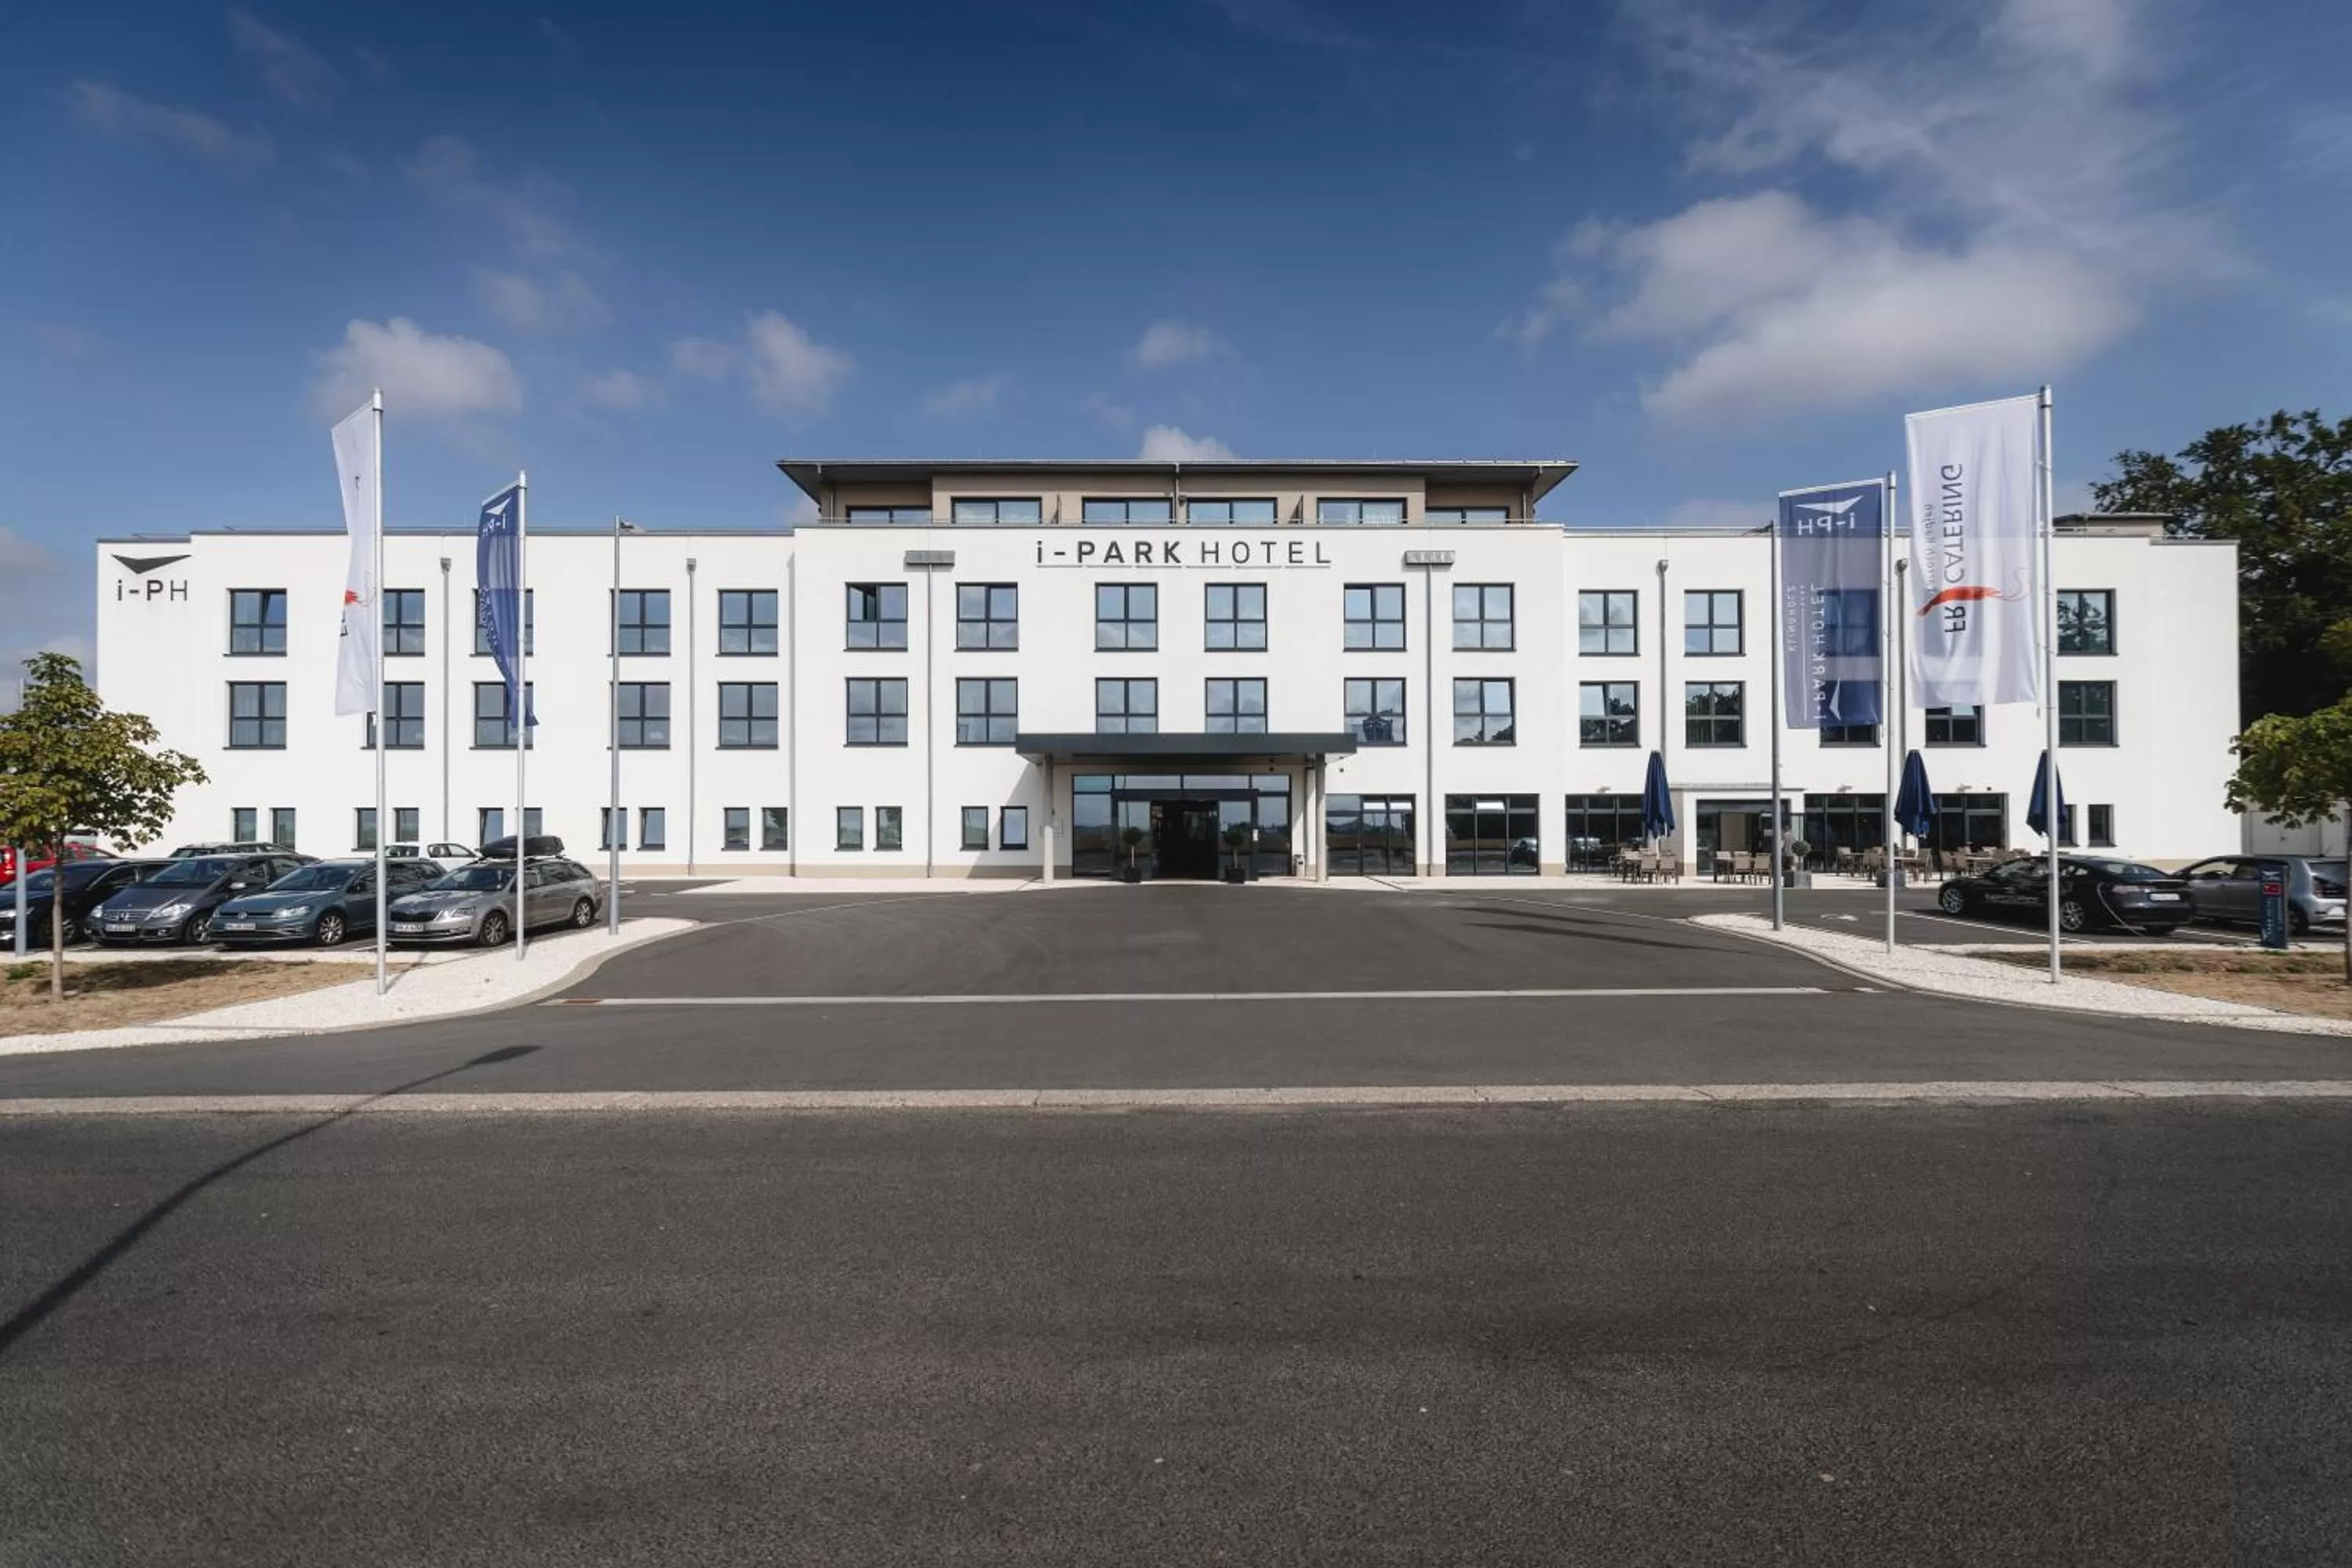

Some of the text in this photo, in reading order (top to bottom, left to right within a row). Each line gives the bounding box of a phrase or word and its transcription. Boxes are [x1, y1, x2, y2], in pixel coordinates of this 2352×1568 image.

[1036, 541, 1331, 564] i-PARK HOTEL
[118, 579, 187, 601] i-PH
